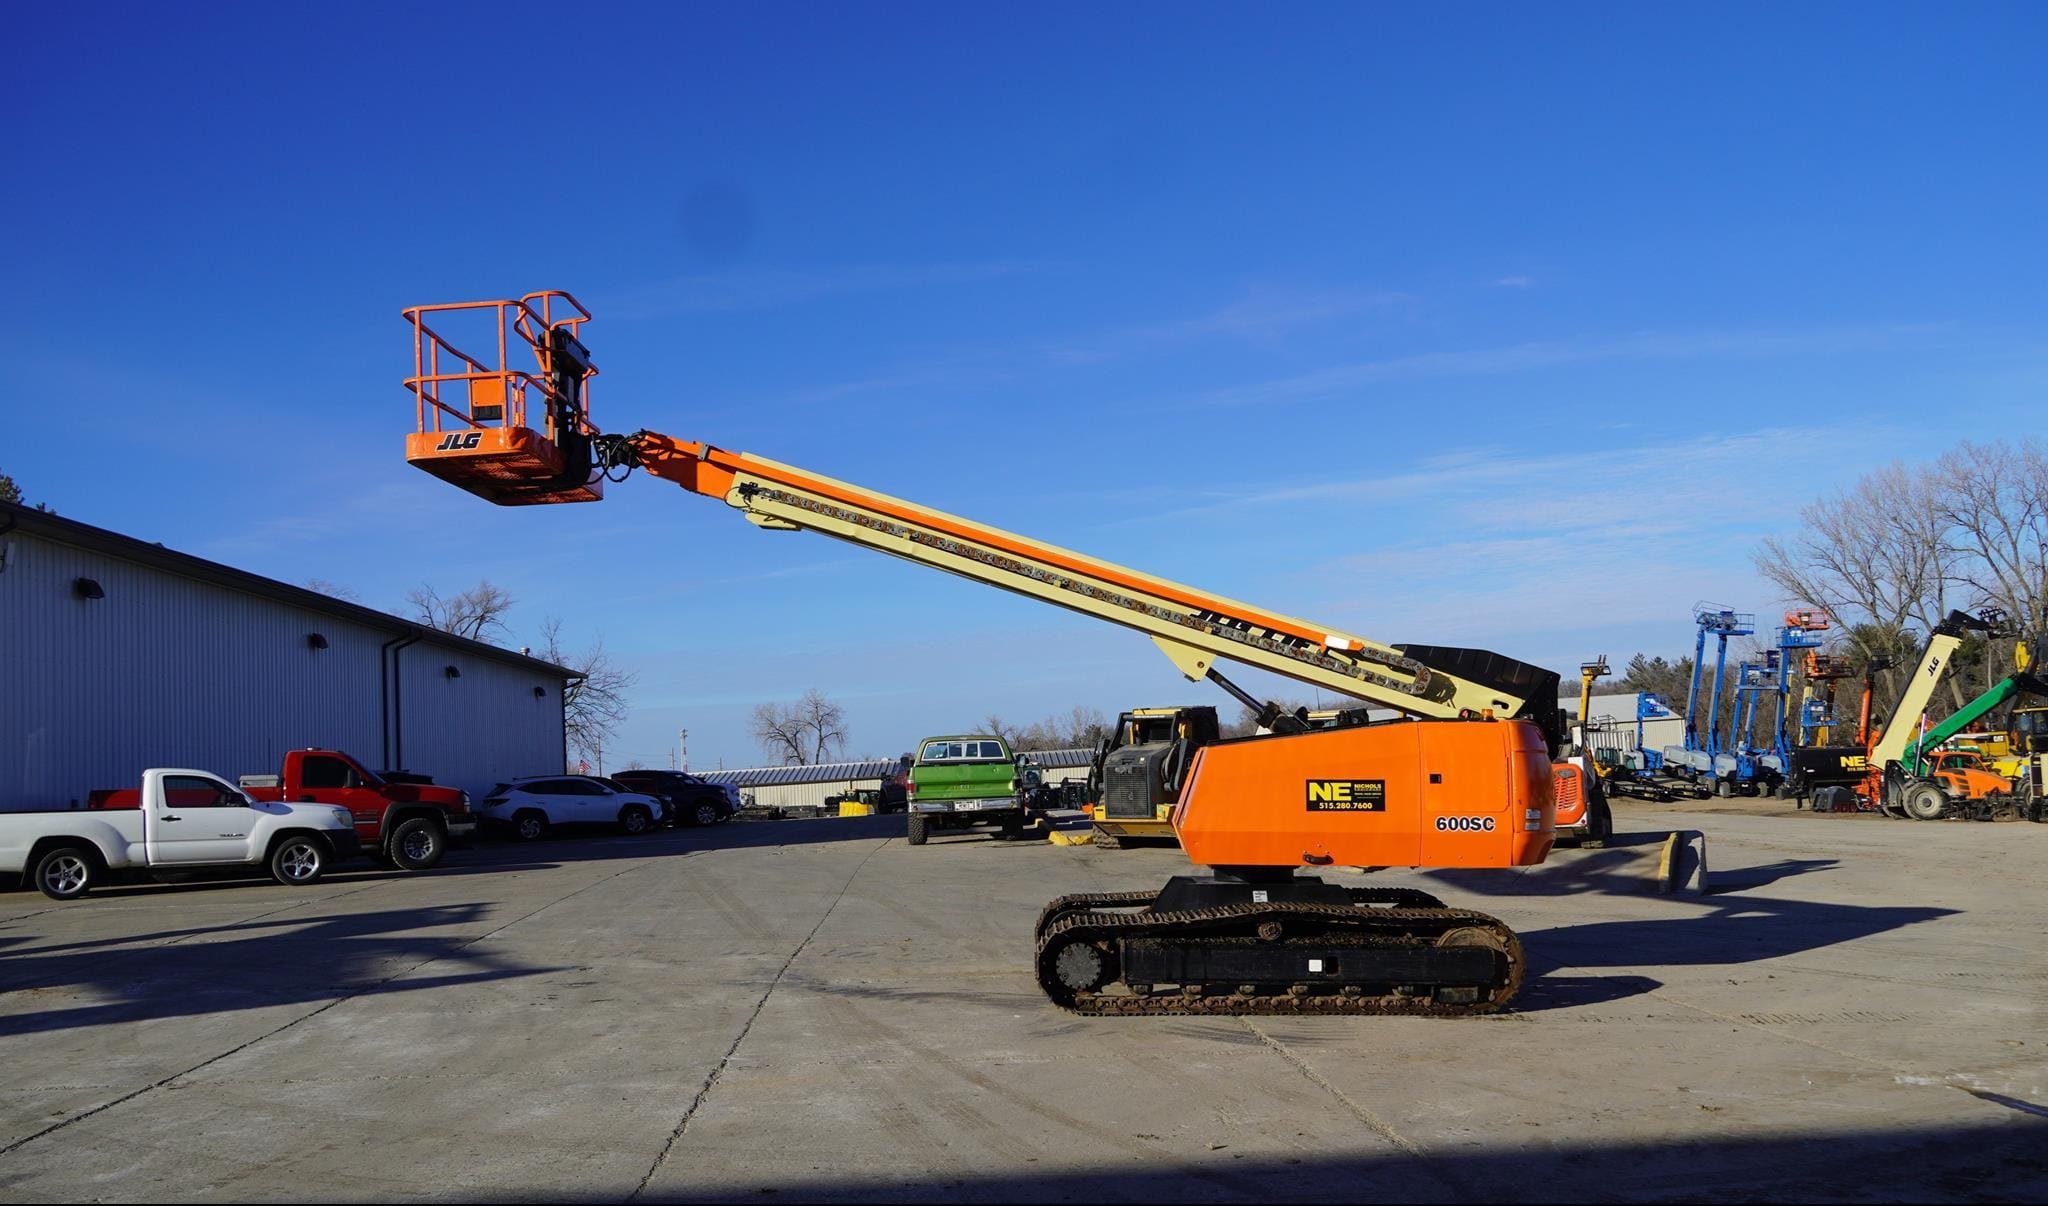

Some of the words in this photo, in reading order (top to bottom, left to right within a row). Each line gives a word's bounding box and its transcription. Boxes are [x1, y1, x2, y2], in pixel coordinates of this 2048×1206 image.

[436, 432, 482, 451] JLG
[1927, 656, 1940, 677] JLG
[1840, 756, 1866, 767] NE
[1309, 782, 1352, 801] NE
[1436, 816, 1496, 832] 600SC
